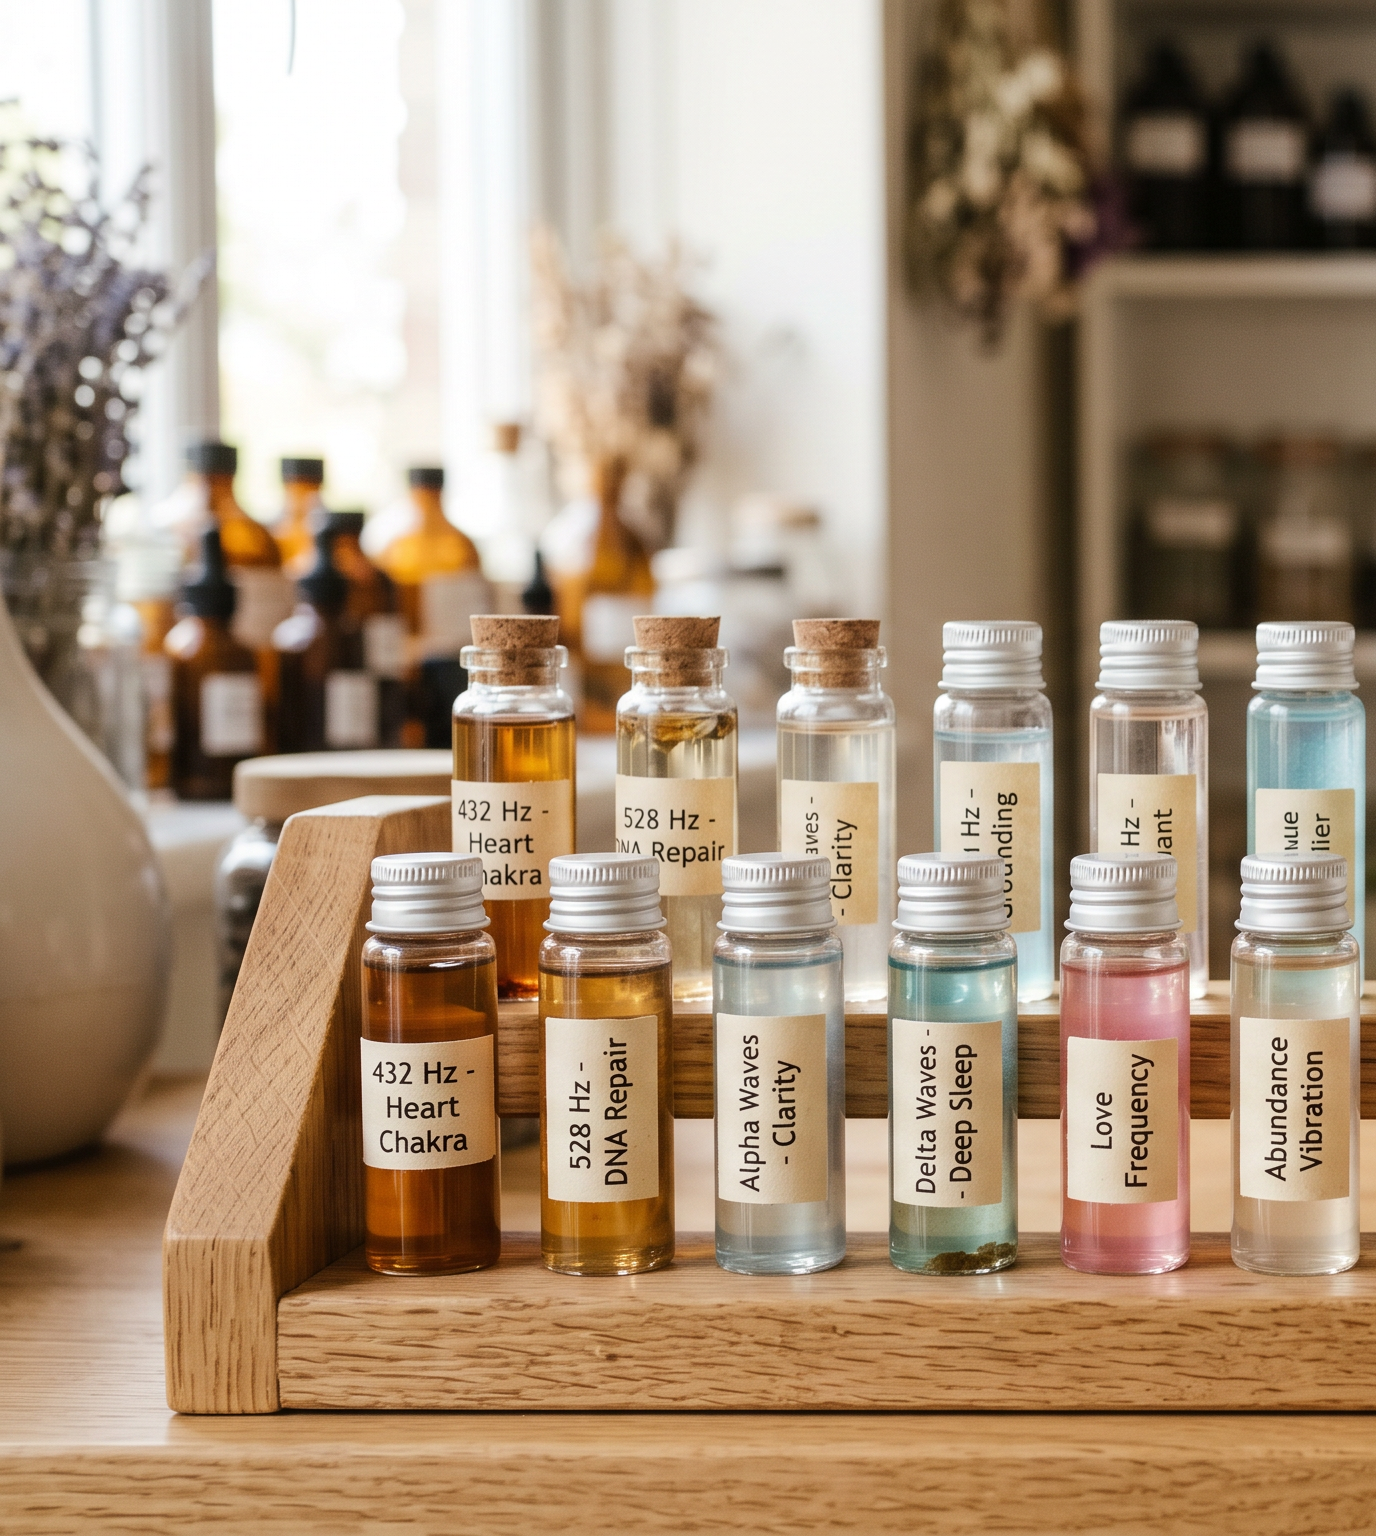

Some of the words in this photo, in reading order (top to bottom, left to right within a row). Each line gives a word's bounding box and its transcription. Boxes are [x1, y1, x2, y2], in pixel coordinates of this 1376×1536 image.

[458, 800, 490, 821] 432
[503, 801, 531, 821] Hz
[625, 807, 658, 829] 528
[670, 809, 699, 830] Hz
[961, 807, 980, 836] Hz
[1121, 817, 1140, 846] Hz
[470, 832, 534, 854] Heart
[651, 839, 727, 869] Repair
[830, 818, 859, 900] Clarity
[483, 862, 543, 887] akra
[372, 1061, 412, 1084] 432
[424, 1062, 457, 1084] Hz
[569, 1081, 590, 1112] Hz
[603, 1037, 633, 1120] Repair
[739, 1035, 759, 1111] Waves
[916, 1046, 936, 1120] Waves
[949, 1044, 977, 1110] Sleep
[387, 1096, 460, 1119] Heart
[772, 1060, 801, 1146] Clarity
[1091, 1092, 1112, 1149] Love
[1125, 1054, 1154, 1187] Frequency
[1264, 1037, 1288, 1181] Abundance
[1299, 1051, 1323, 1172] Vibration
[380, 1130, 468, 1154] Chakra
[569, 1124, 591, 1169] 528
[604, 1129, 628, 1185] DNA
[738, 1121, 766, 1192] Alpha
[915, 1130, 936, 1193] Delta
[950, 1120, 978, 1182] Deep
